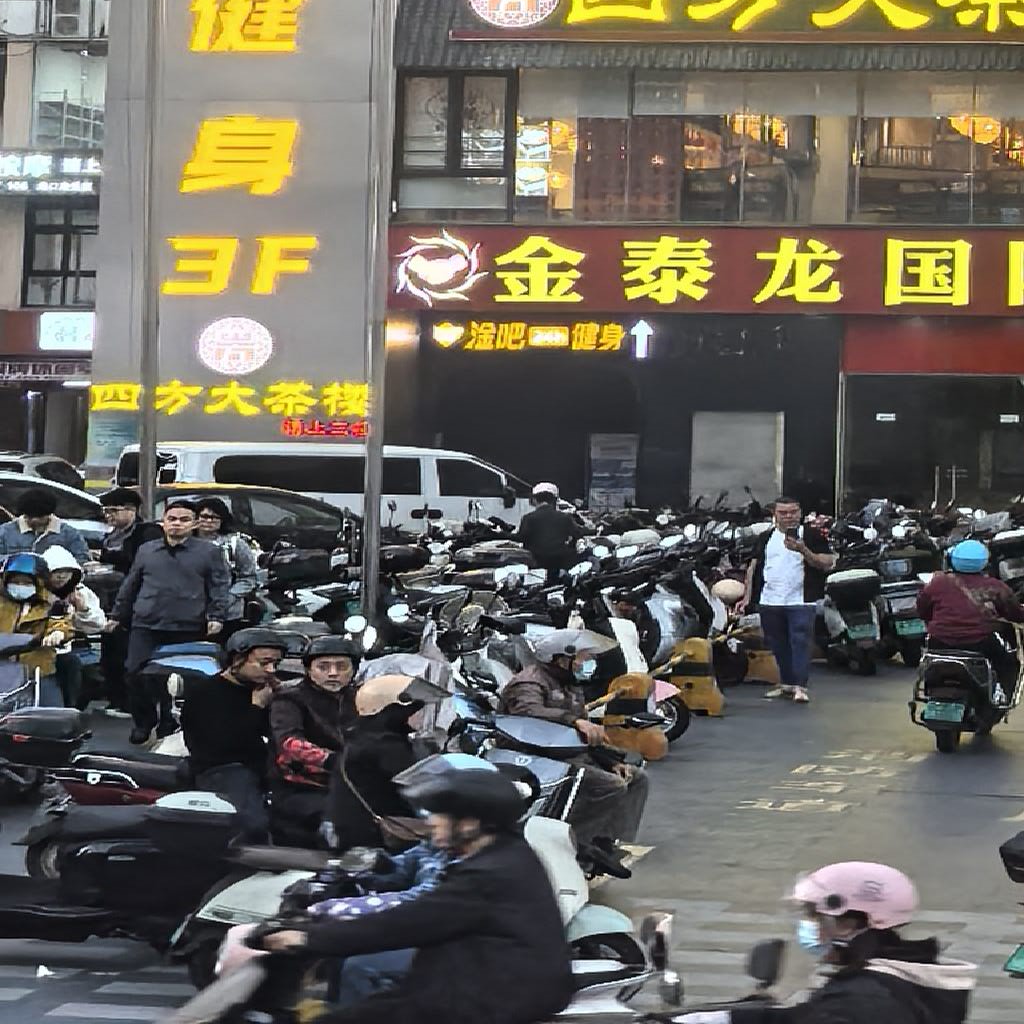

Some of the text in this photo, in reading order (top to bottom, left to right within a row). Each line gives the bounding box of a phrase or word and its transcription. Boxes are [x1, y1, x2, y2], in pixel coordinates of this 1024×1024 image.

[160, 235, 319, 295] 3F
[571, 320, 626, 351] 健身
[90, 379, 369, 418] 四方大茶楼
